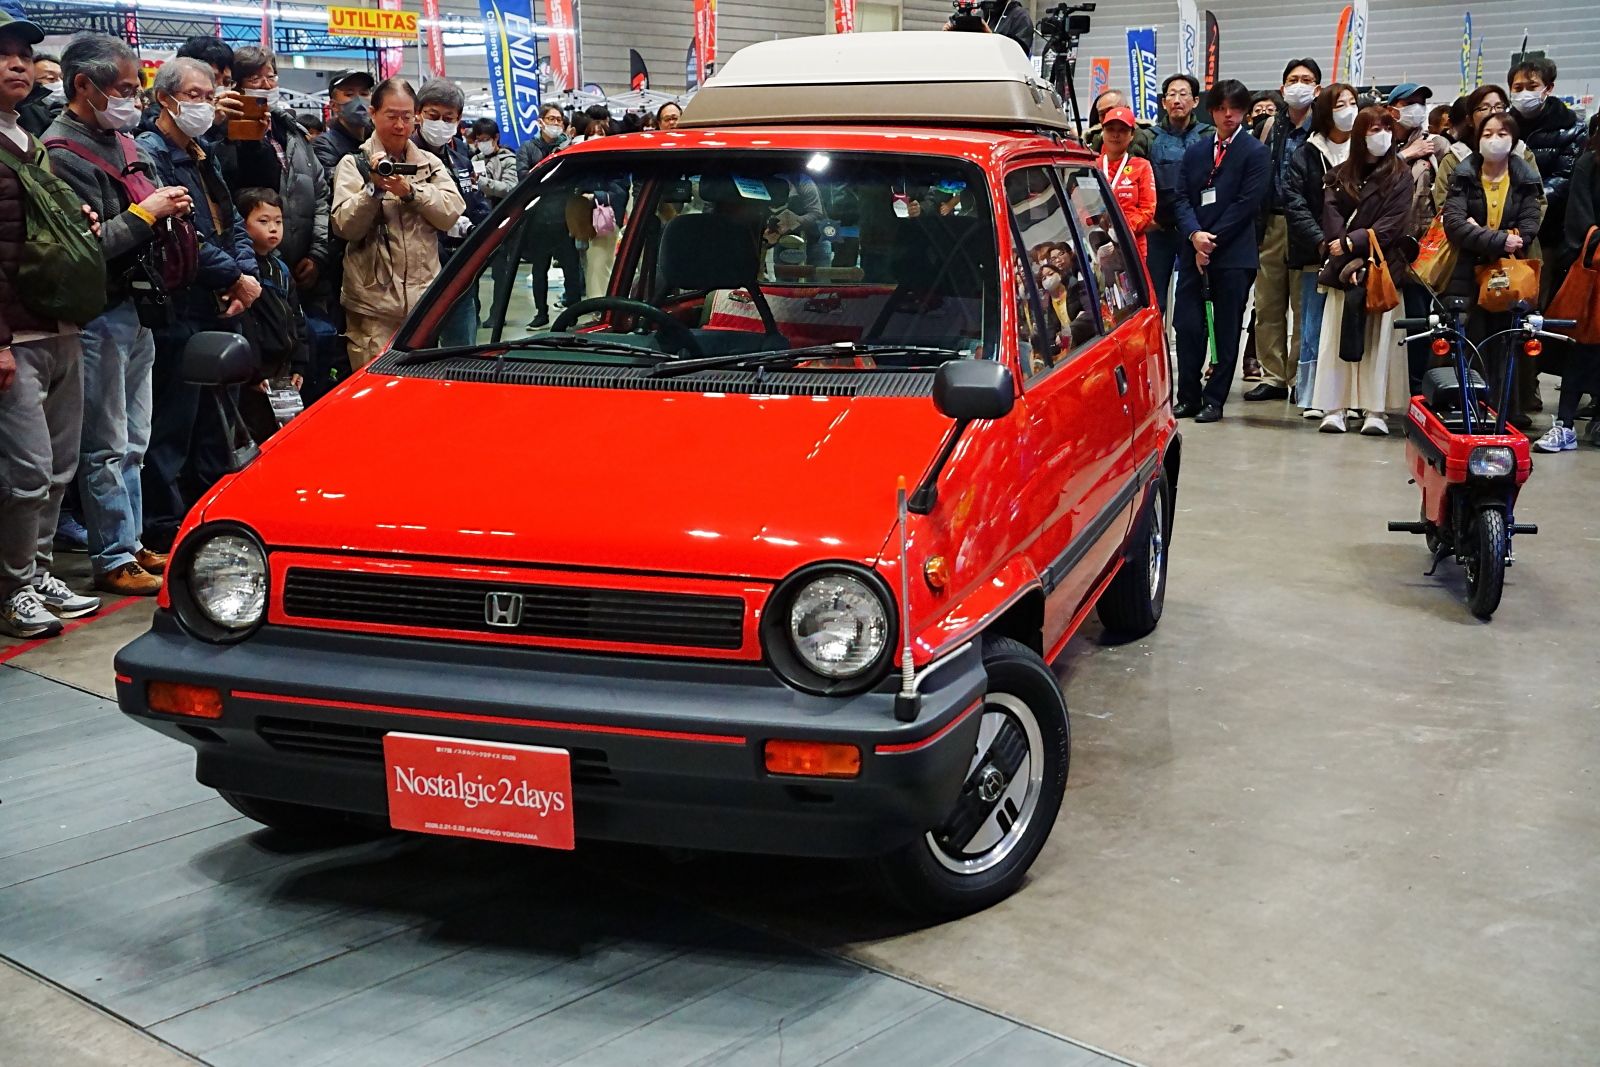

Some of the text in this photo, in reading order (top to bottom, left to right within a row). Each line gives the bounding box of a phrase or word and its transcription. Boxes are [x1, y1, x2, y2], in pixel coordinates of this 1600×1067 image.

[331, 10, 417, 31] UTILITAS
[486, 10, 510, 133] Challenge to the Future
[504, 11, 541, 137] ENDLESS
[1131, 48, 1139, 85] Challenge
[1134, 86, 1140, 95] to
[1141, 49, 1158, 120] ENDLES
[393, 765, 565, 818] Nostalgic 2days
